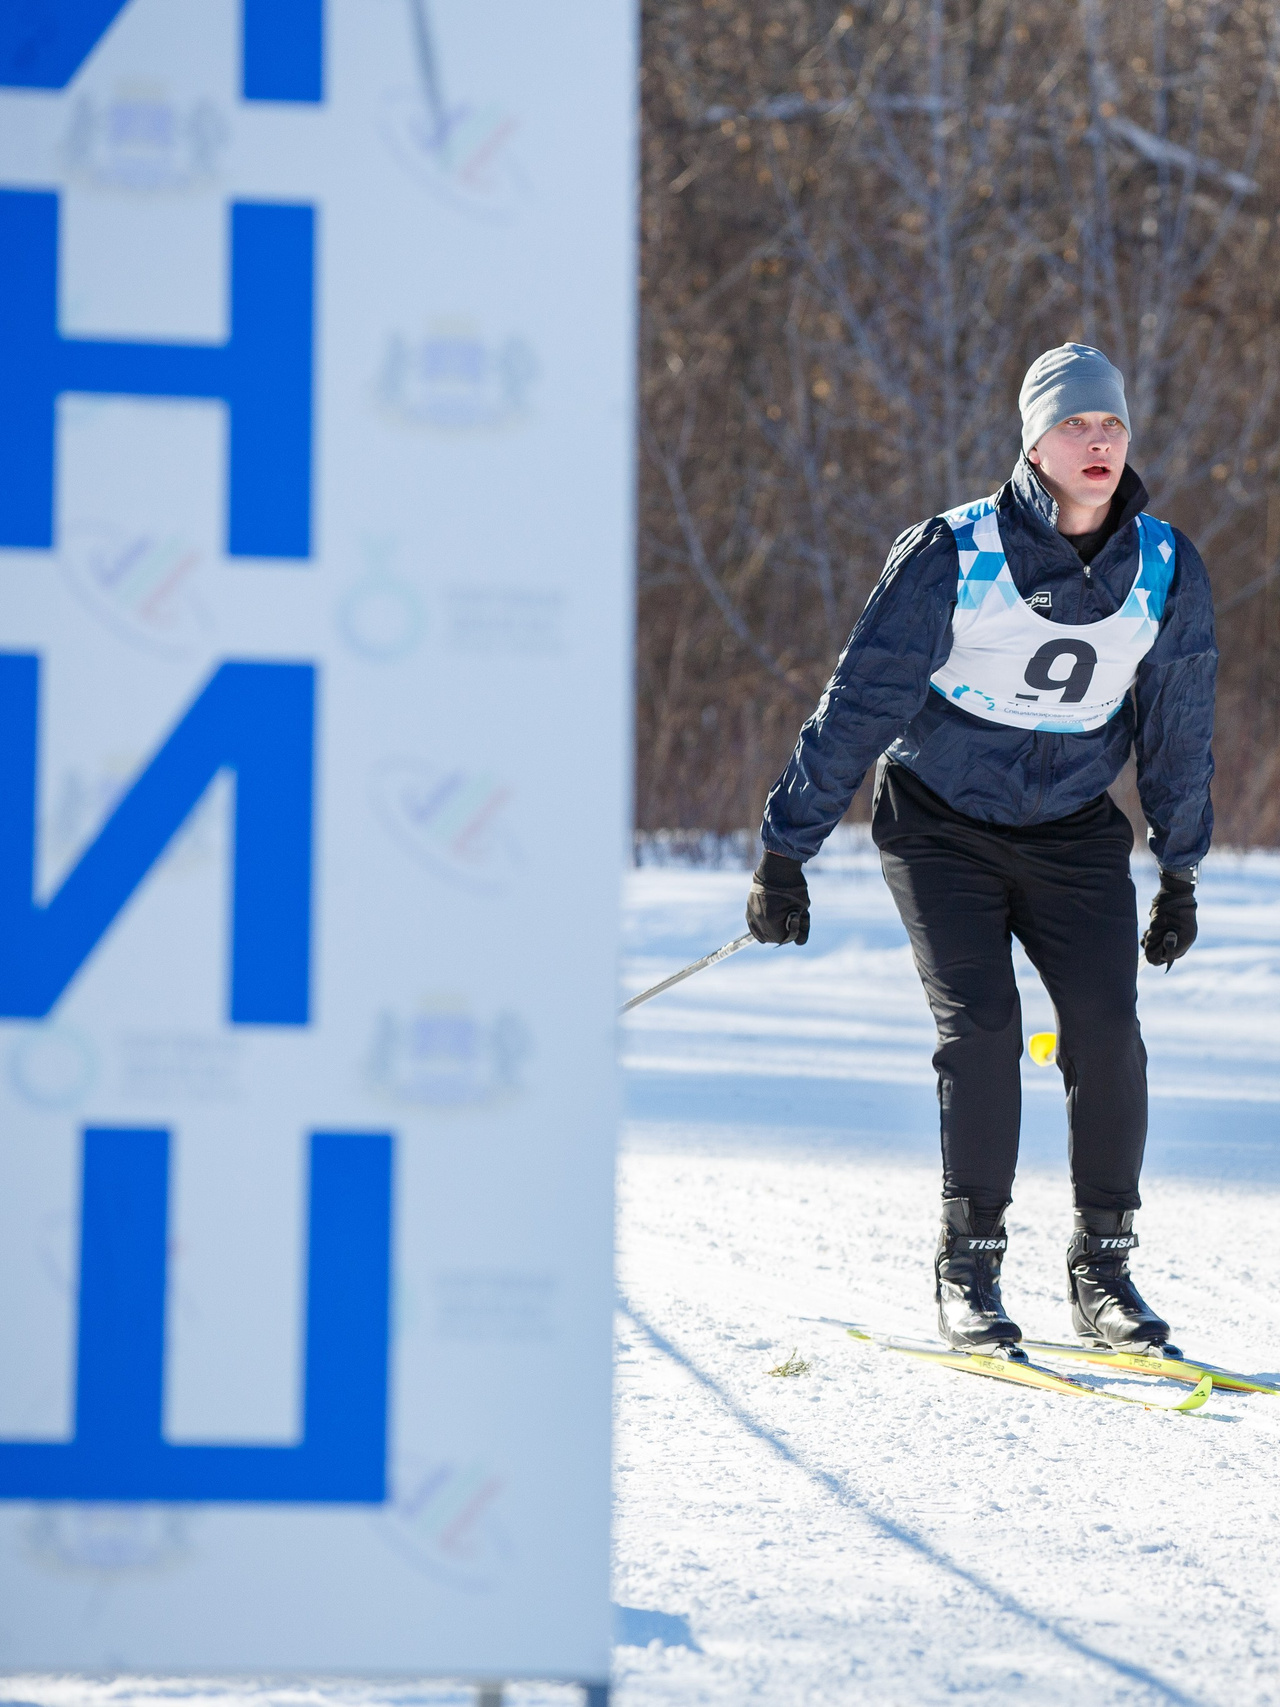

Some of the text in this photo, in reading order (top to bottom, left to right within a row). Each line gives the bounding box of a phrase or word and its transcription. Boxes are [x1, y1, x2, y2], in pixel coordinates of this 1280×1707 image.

[1015, 638, 1098, 703] 9
[968, 1239, 1007, 1250] TISA
[1100, 1237, 1136, 1249] TISA
[1133, 1358, 1162, 1370] FISCHER
